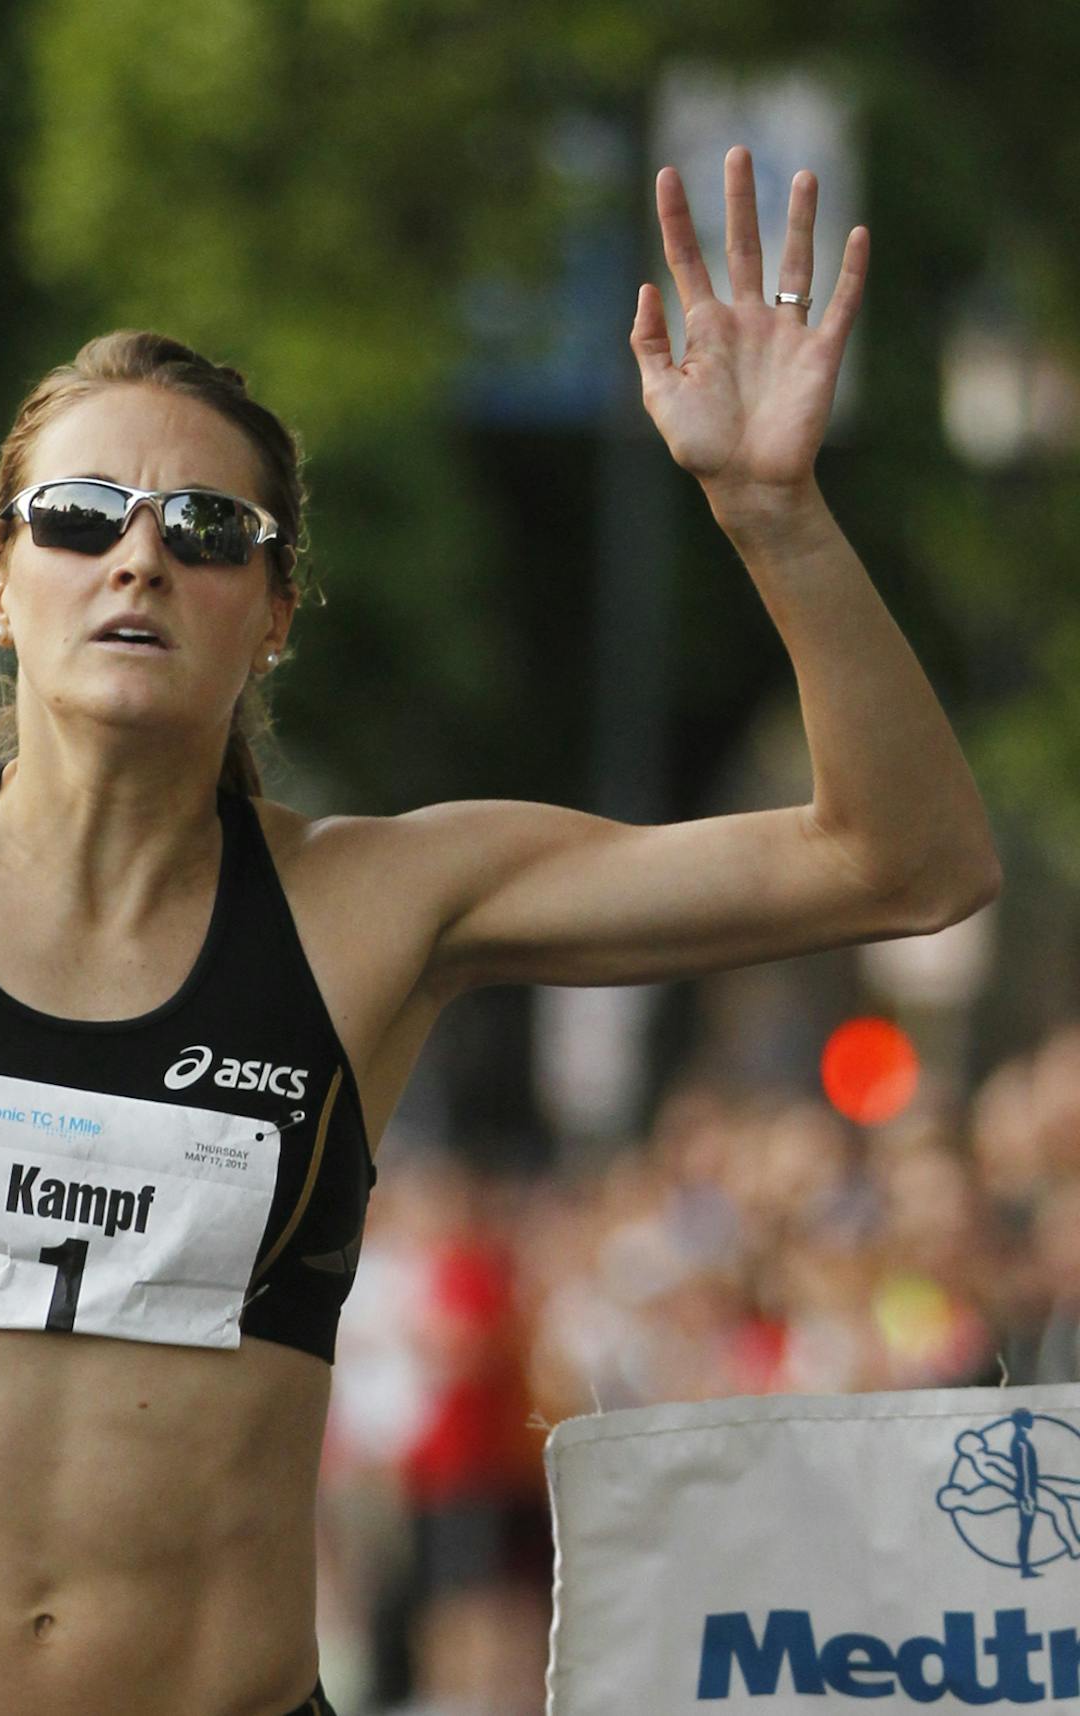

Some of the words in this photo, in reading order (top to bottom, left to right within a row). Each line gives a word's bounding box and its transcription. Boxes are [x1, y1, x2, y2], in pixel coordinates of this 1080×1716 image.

[214, 1058, 309, 1100] asics
[31, 1110, 53, 1126] TC
[58, 1115, 65, 1129] 1
[69, 1117, 102, 1135] Mile
[185, 1152, 207, 1162] MAY
[210, 1156, 223, 1168] 17,
[224, 1158, 248, 1170] 2012
[195, 1143, 249, 1159] THURSDAY
[6, 1163, 156, 1237] Kampf
[39, 1237, 89, 1332] 1
